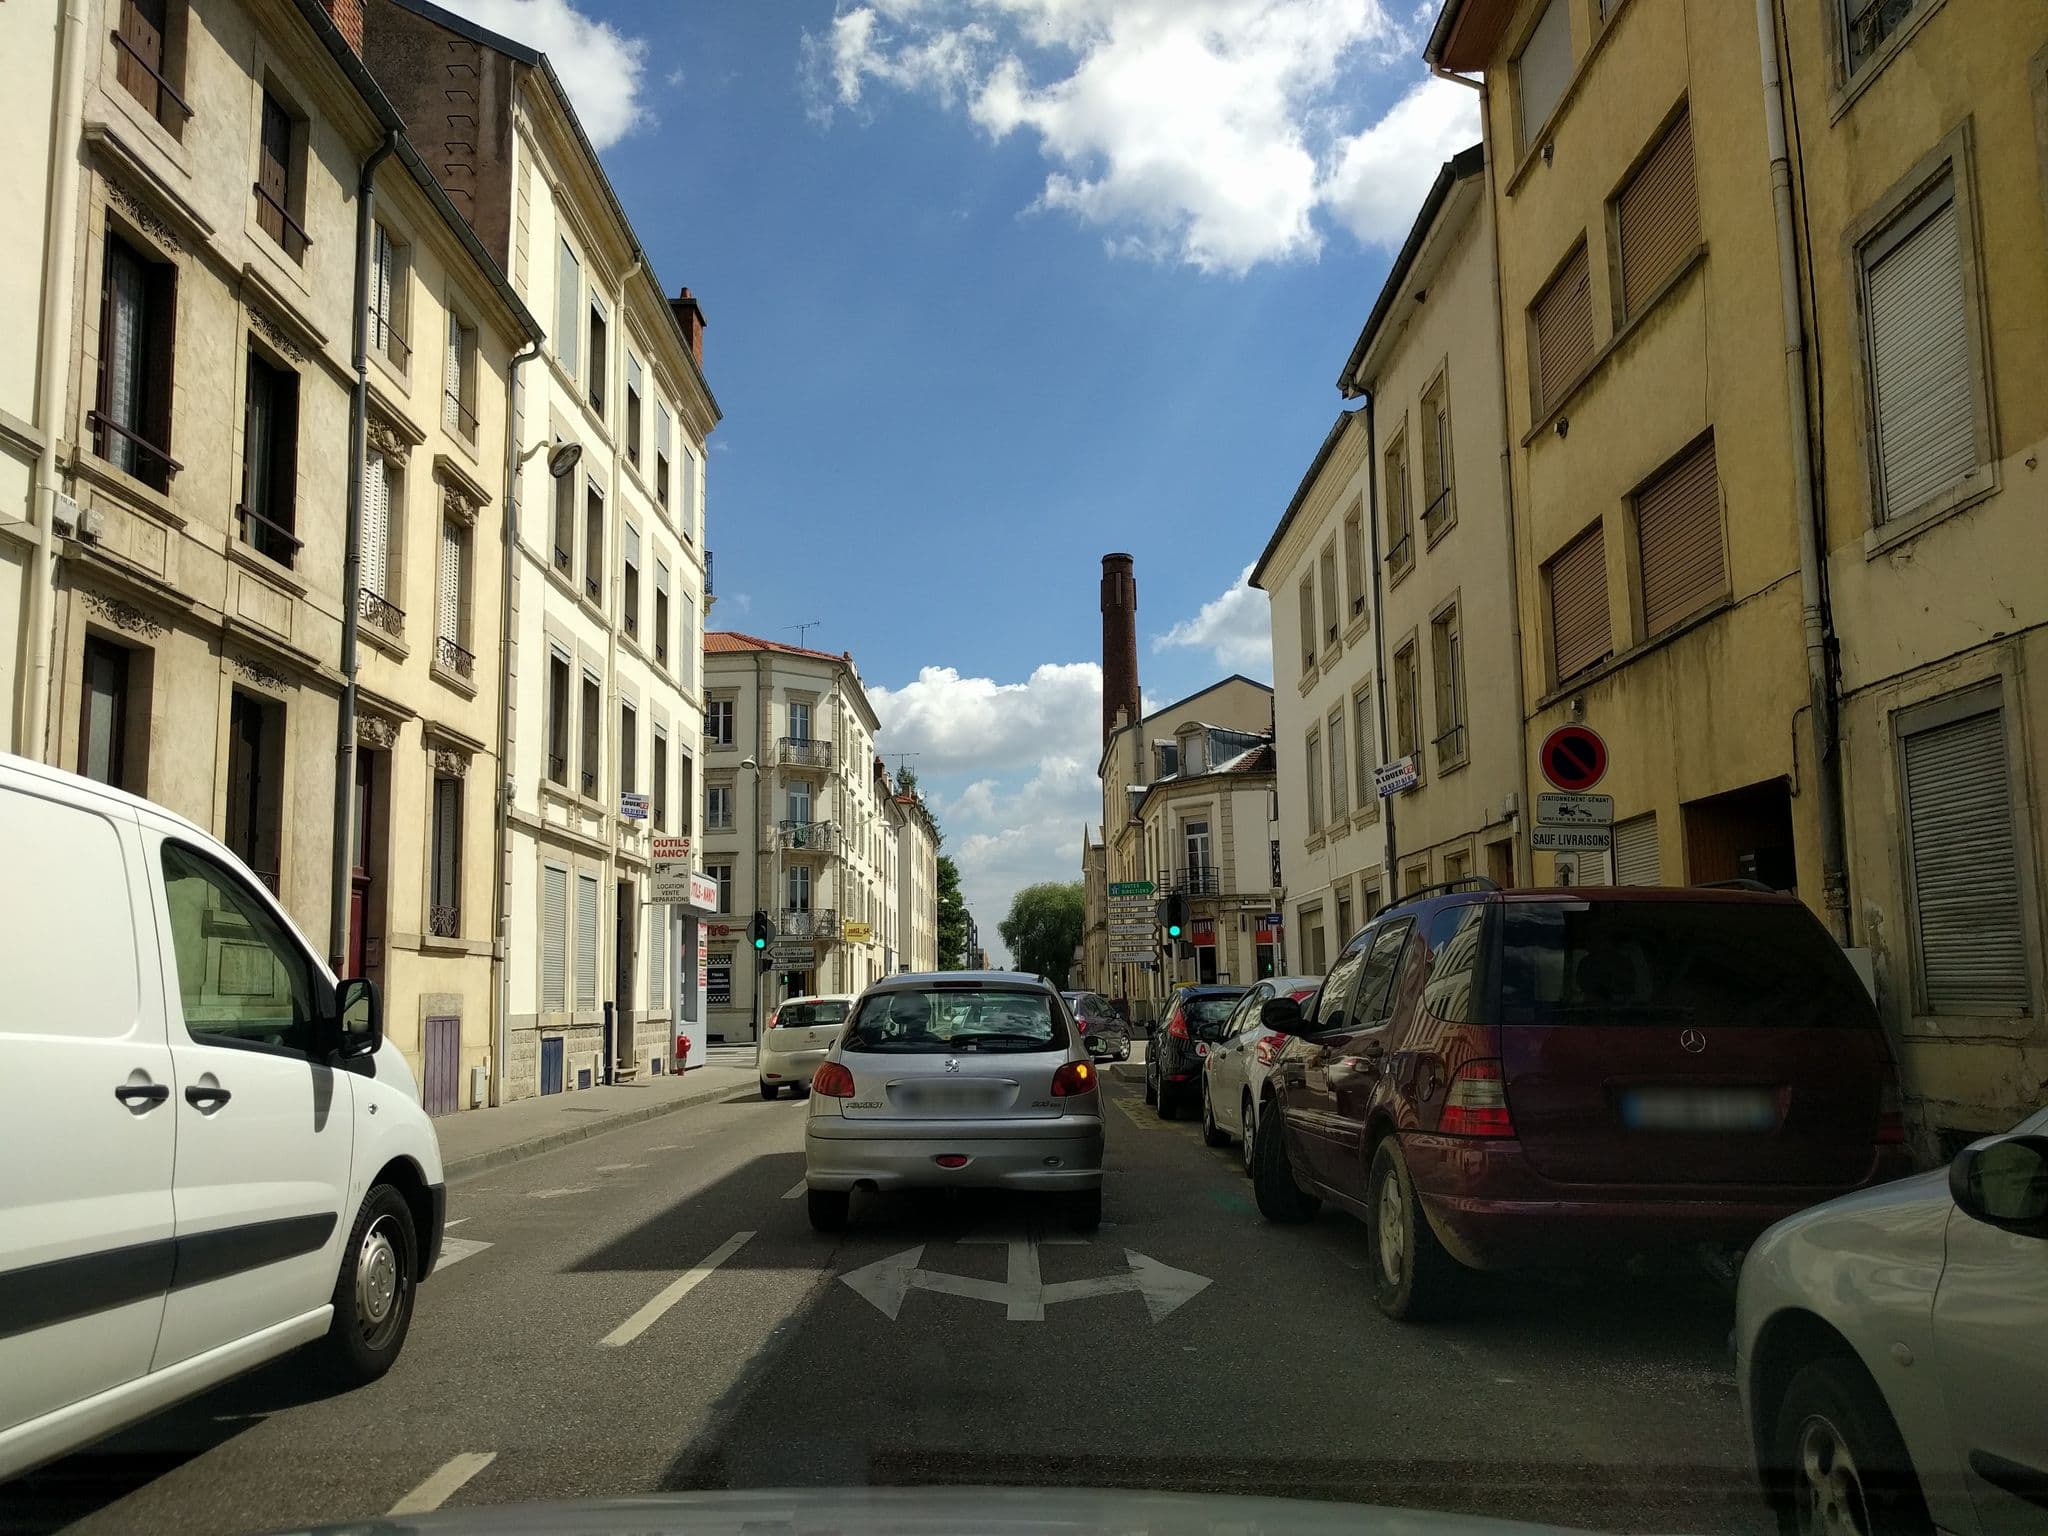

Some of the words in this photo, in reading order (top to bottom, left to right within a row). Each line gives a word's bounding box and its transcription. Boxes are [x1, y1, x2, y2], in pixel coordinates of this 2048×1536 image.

[1382, 769, 1404, 782] LOUER
[653, 839, 690, 848] OUTILS
[1533, 833, 1556, 845] SAUF
[1558, 834, 1610, 846] LIVRAISONS
[653, 849, 689, 858] NANCY
[1199, 1043, 1207, 1054] A
